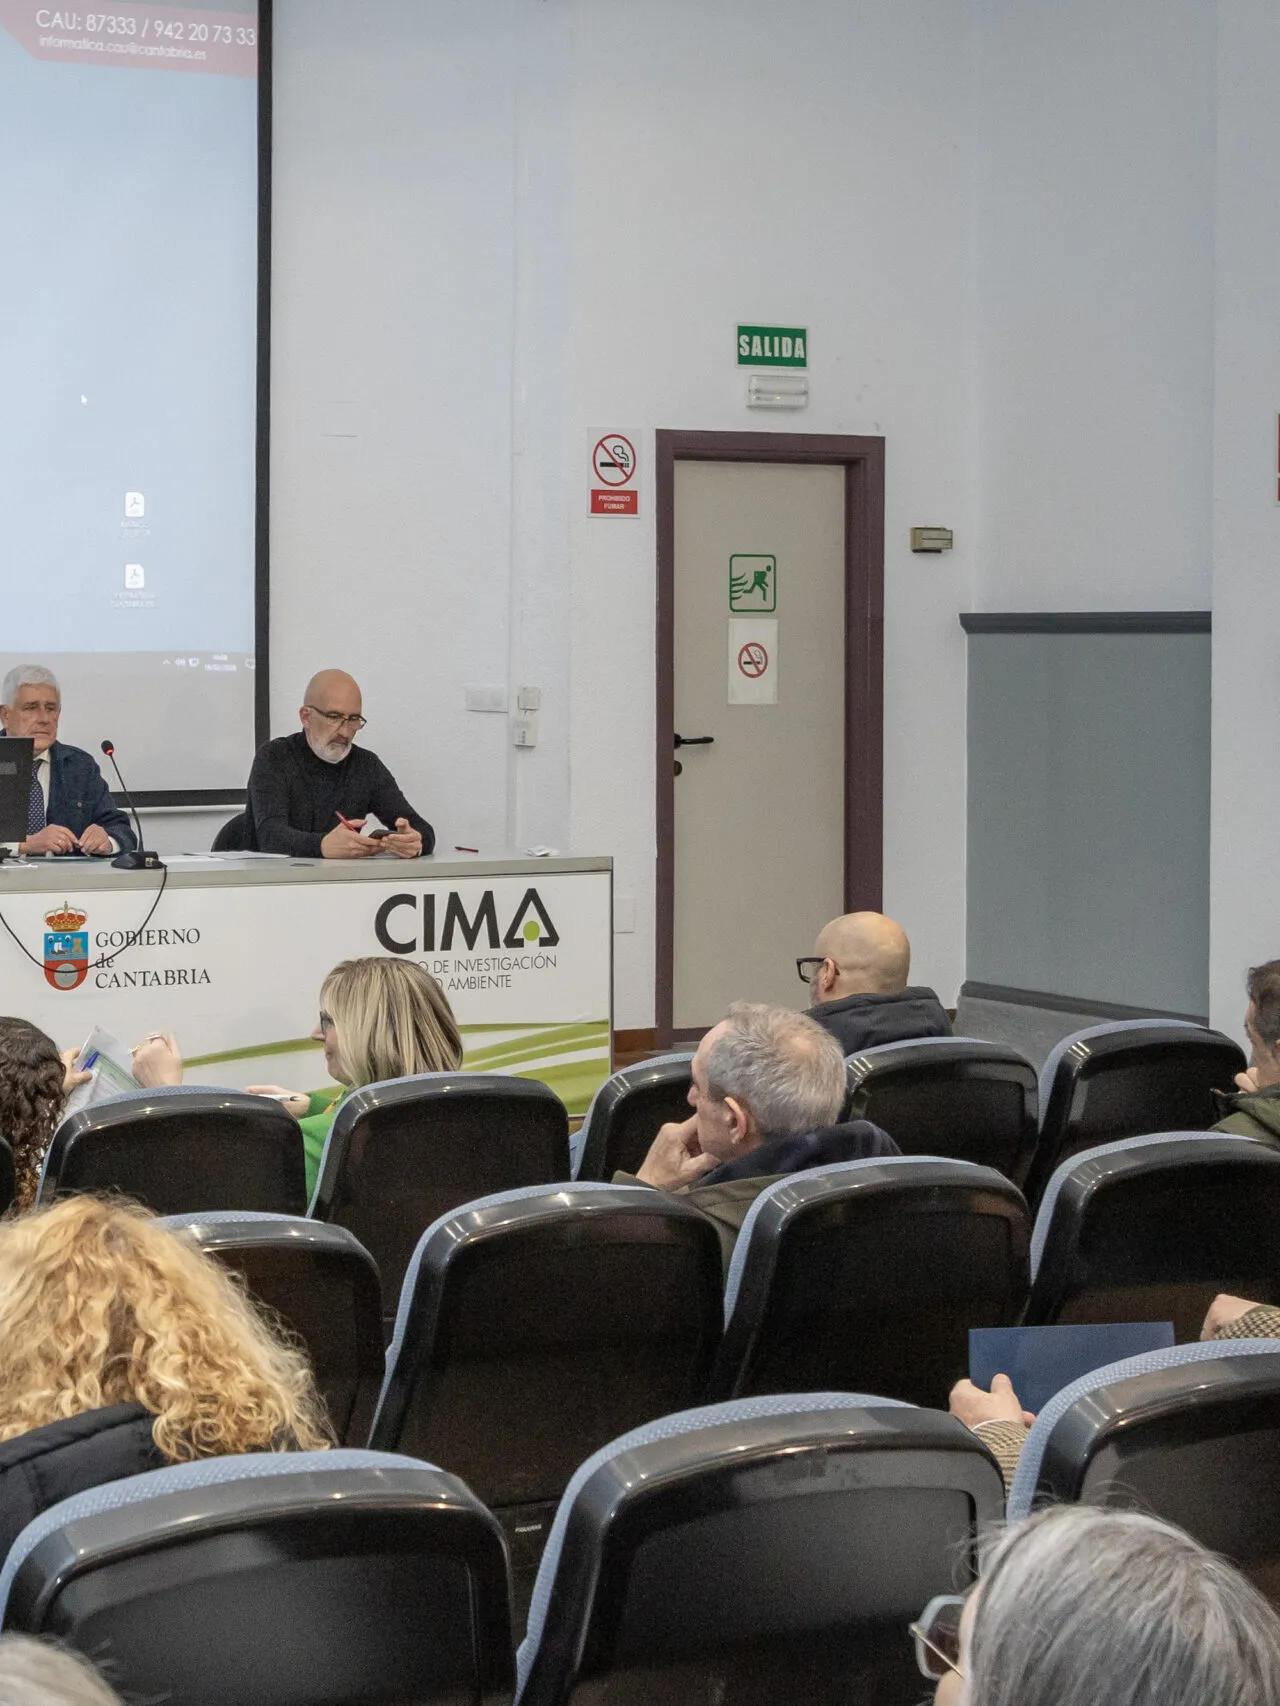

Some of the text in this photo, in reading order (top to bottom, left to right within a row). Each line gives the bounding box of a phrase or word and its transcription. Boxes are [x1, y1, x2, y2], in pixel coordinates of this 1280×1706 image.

[35, 9, 257, 46] CAU: 87333 / 942 20 73 33
[738, 334, 805, 359] SALIDA
[374, 887, 561, 955] CIMA
[95, 928, 201, 949] GOBIERNO
[95, 952, 115, 969] de
[433, 959, 450, 975] DE
[454, 952, 558, 973] INVESTIGACIÓN
[94, 968, 212, 989] CANTABRIA
[447, 974, 513, 992] AMBIENTE
